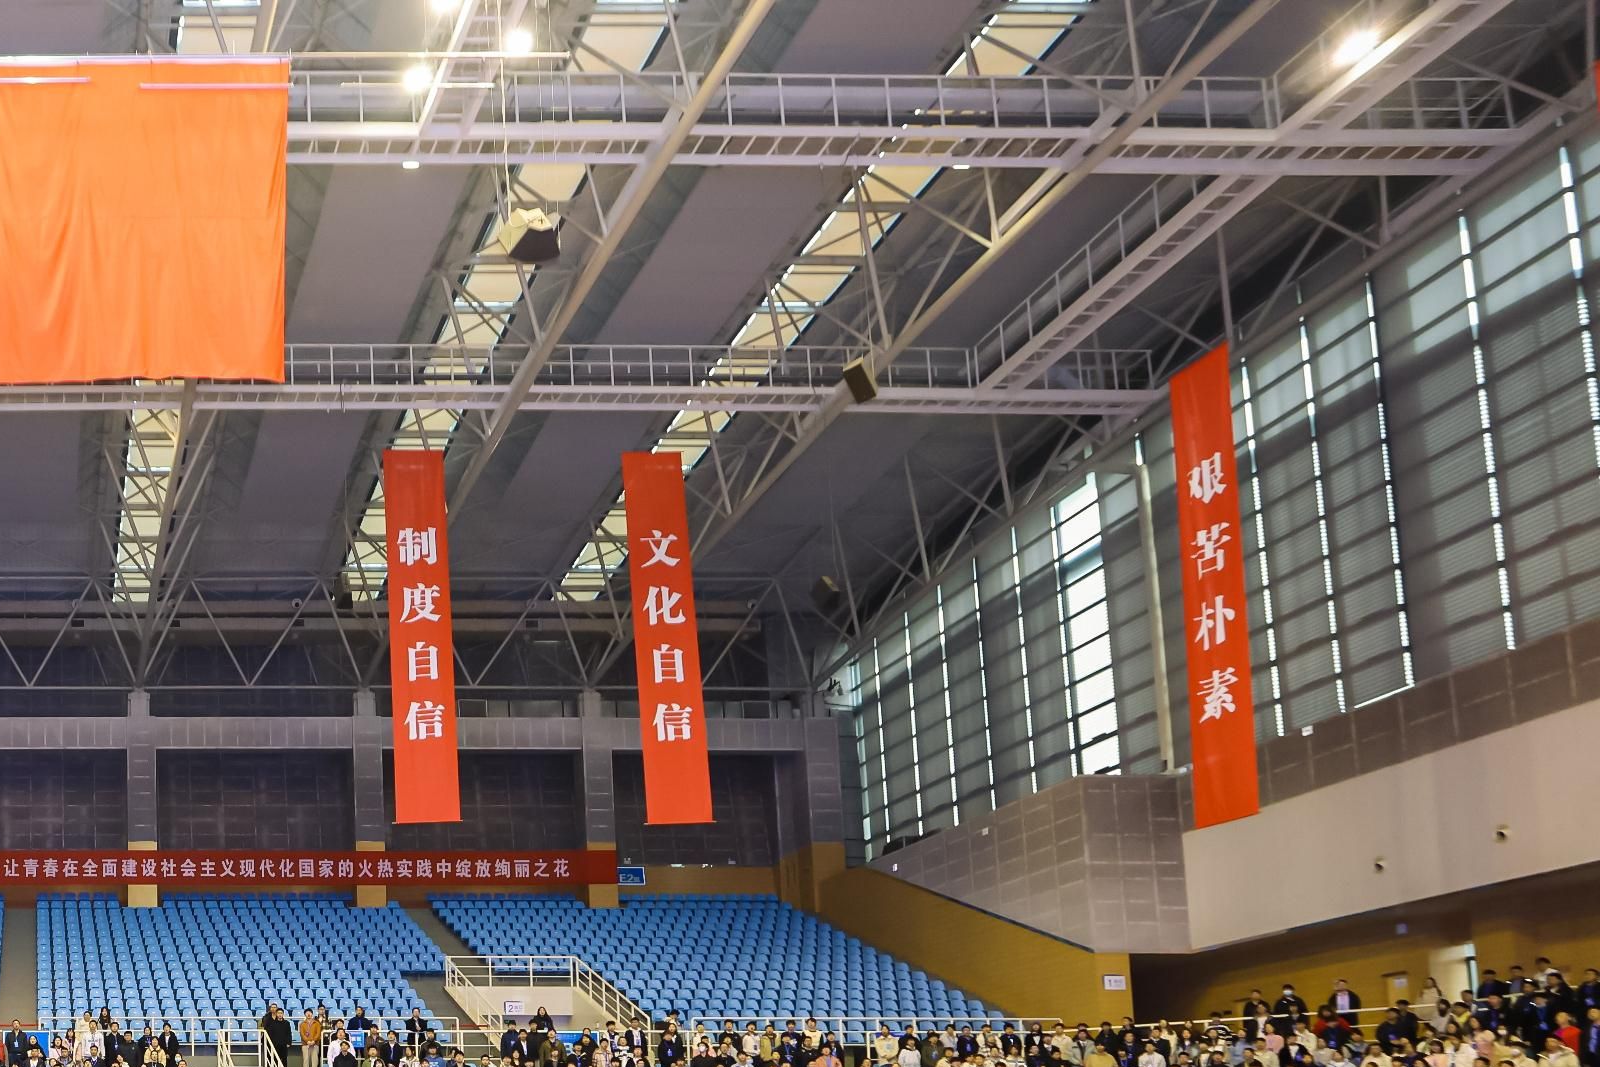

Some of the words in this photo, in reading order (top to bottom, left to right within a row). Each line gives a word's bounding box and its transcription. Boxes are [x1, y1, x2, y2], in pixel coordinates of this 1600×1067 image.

[397, 527, 445, 740] 制度自信
[640, 530, 693, 741] 文化自信
[1187, 452, 1239, 723] 艰苦朴素
